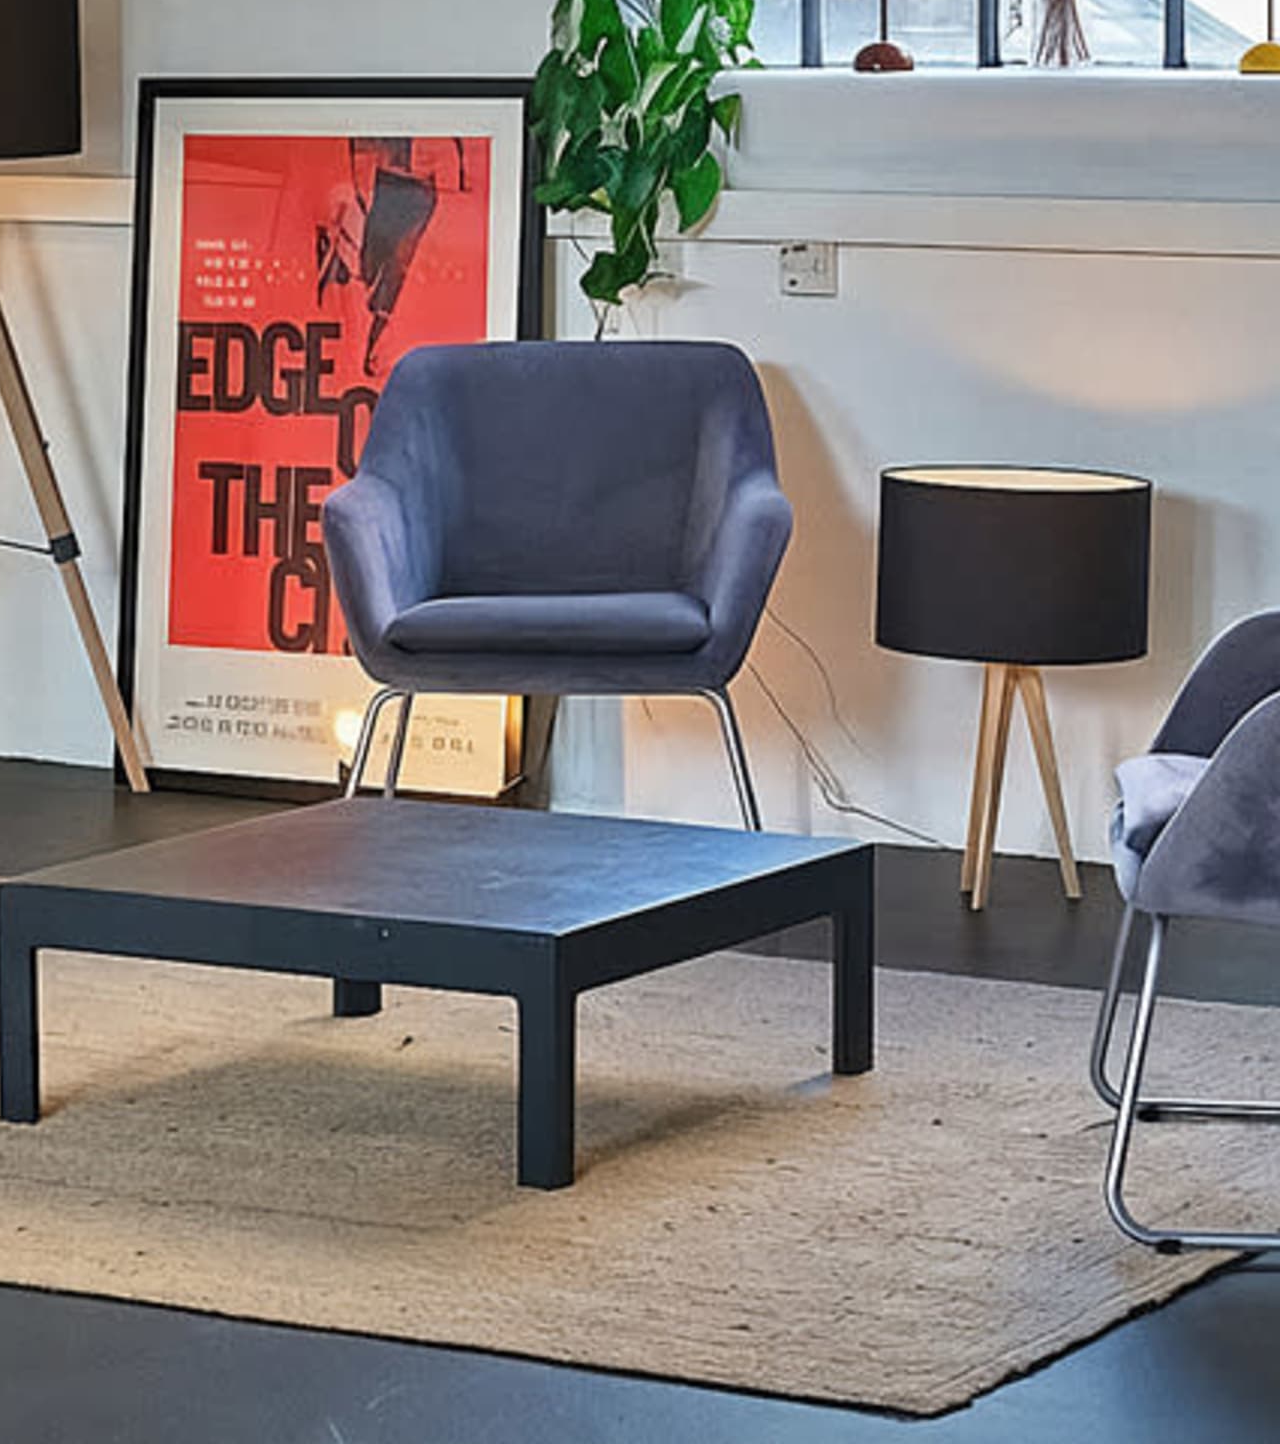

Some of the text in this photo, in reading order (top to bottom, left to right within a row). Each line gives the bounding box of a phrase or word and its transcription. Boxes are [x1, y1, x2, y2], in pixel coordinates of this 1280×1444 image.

[176, 321, 342, 416] EDGE
[336, 386, 379, 480] O
[197, 460, 332, 559] THE
[268, 556, 354, 656] CI
